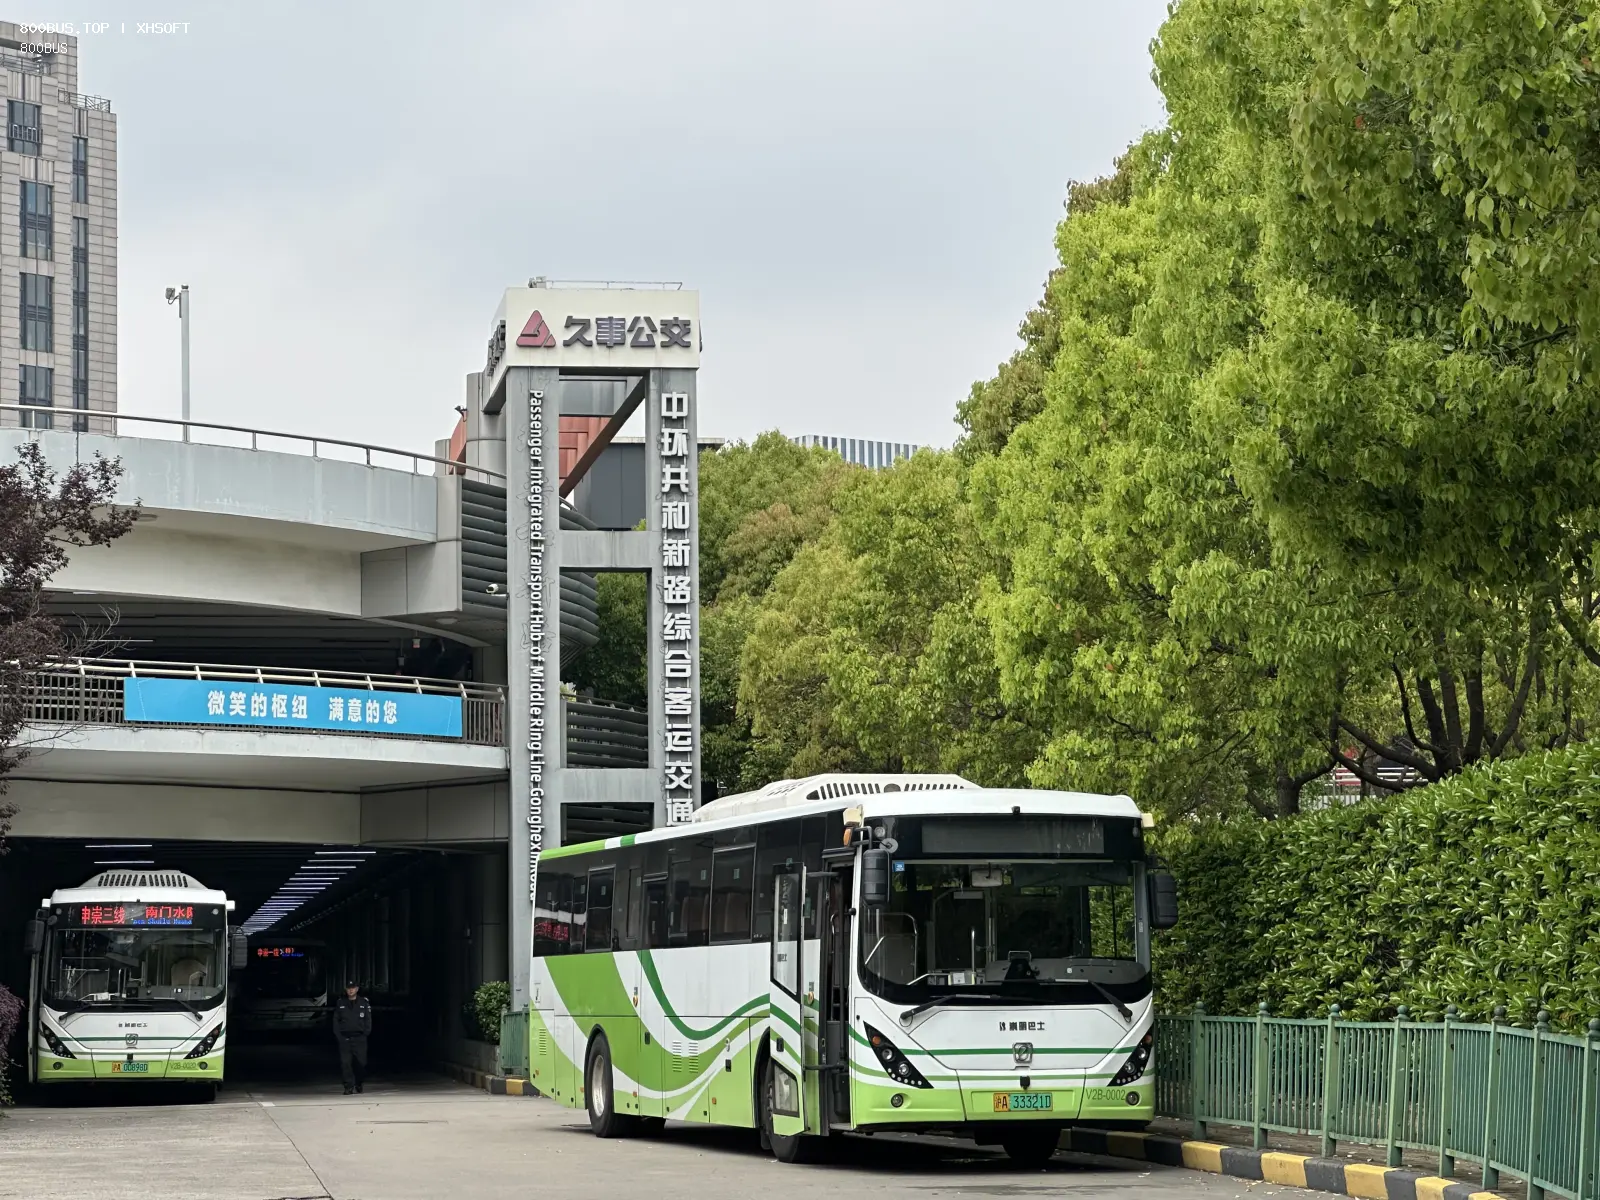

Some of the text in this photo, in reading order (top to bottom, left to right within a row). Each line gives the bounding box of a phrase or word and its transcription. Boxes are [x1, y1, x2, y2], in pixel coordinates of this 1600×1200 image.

[563, 315, 692, 348] 久事公交
[528, 389, 544, 461] Passenger
[527, 466, 545, 540] Integrated
[527, 544, 545, 612] Transport
[660, 391, 693, 826] 中环共和新路综合客运交通
[529, 614, 546, 641] Hub
[529, 646, 546, 662] of
[530, 664, 545, 716] Middle
[207, 689, 397, 725] 微笑的枢纽 满意的您
[527, 718, 545, 750] Ring
[529, 752, 546, 782] Line
[81, 906, 126, 924] 申崇三线
[1013, 1095, 1051, 1109] 33321D
[1086, 1089, 1126, 1101] V2B-0002
